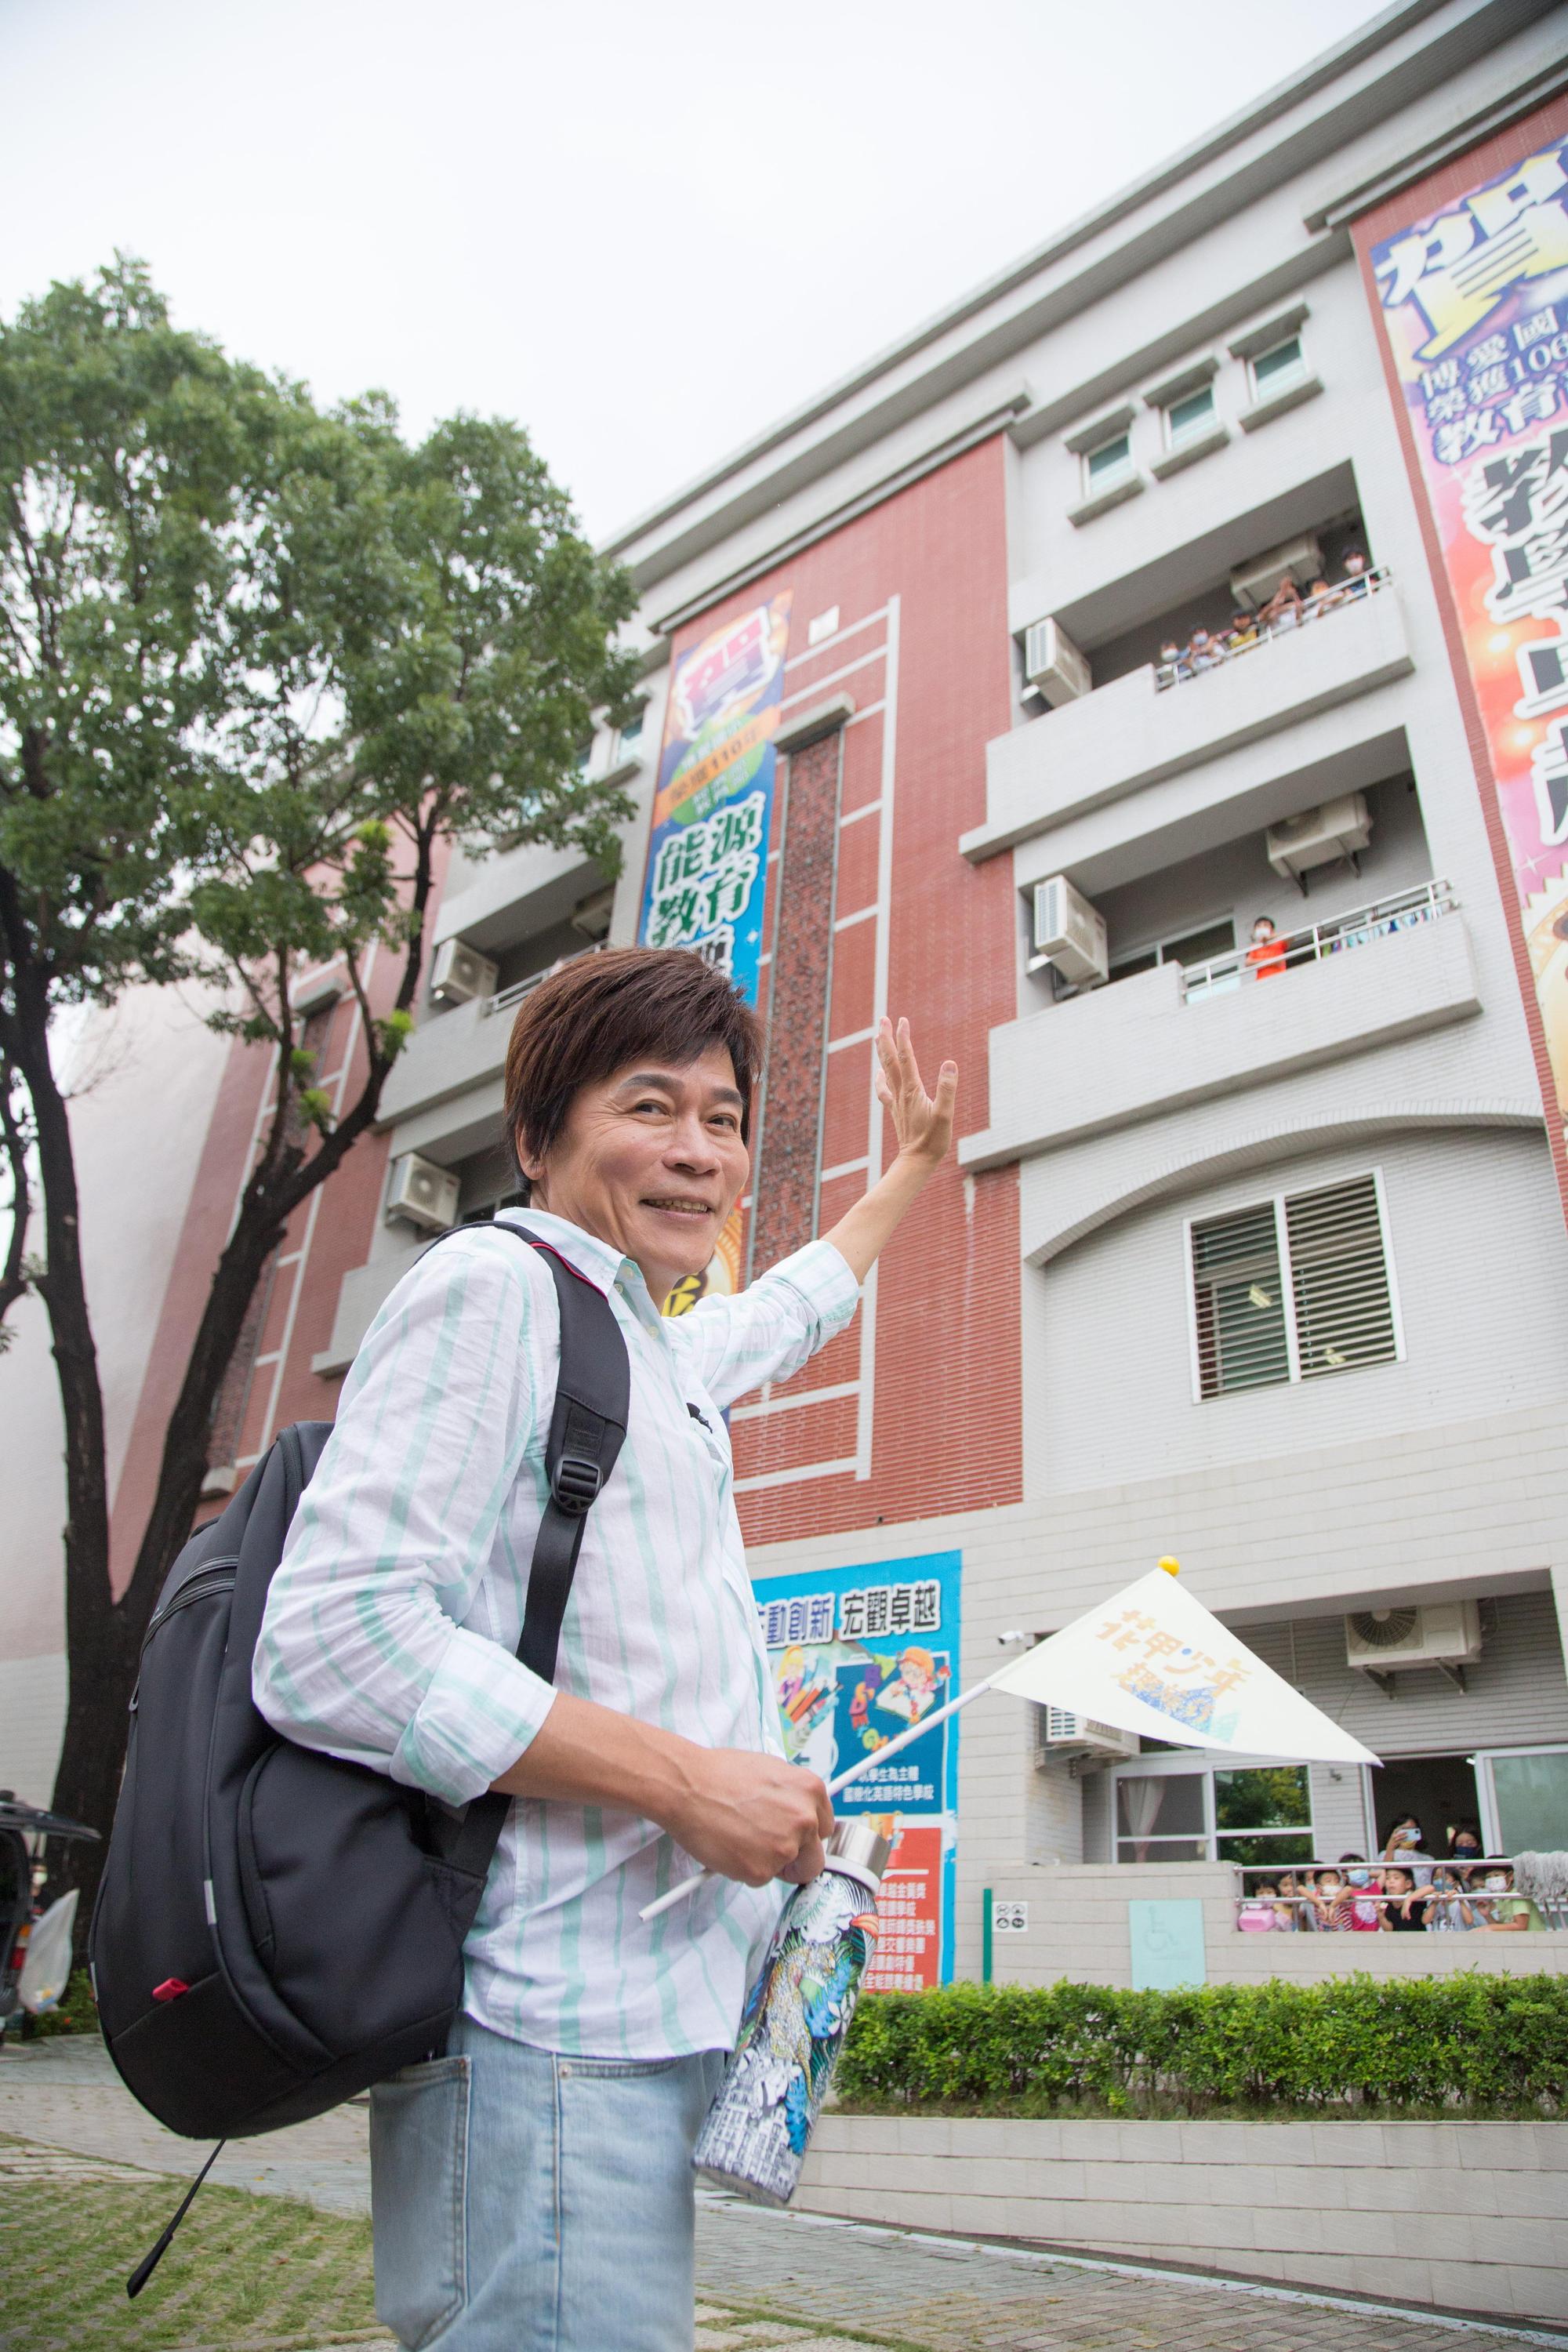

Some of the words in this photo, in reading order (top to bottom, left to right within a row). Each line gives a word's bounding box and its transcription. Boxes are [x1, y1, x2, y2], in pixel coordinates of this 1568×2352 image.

[1421, 307, 1568, 400] 博愛國
[1434, 371, 1568, 464] 教育
[655, 797, 759, 893] 能源
[651, 859, 754, 948] 教育
[843, 1584, 937, 1636] 宏觀卓越
